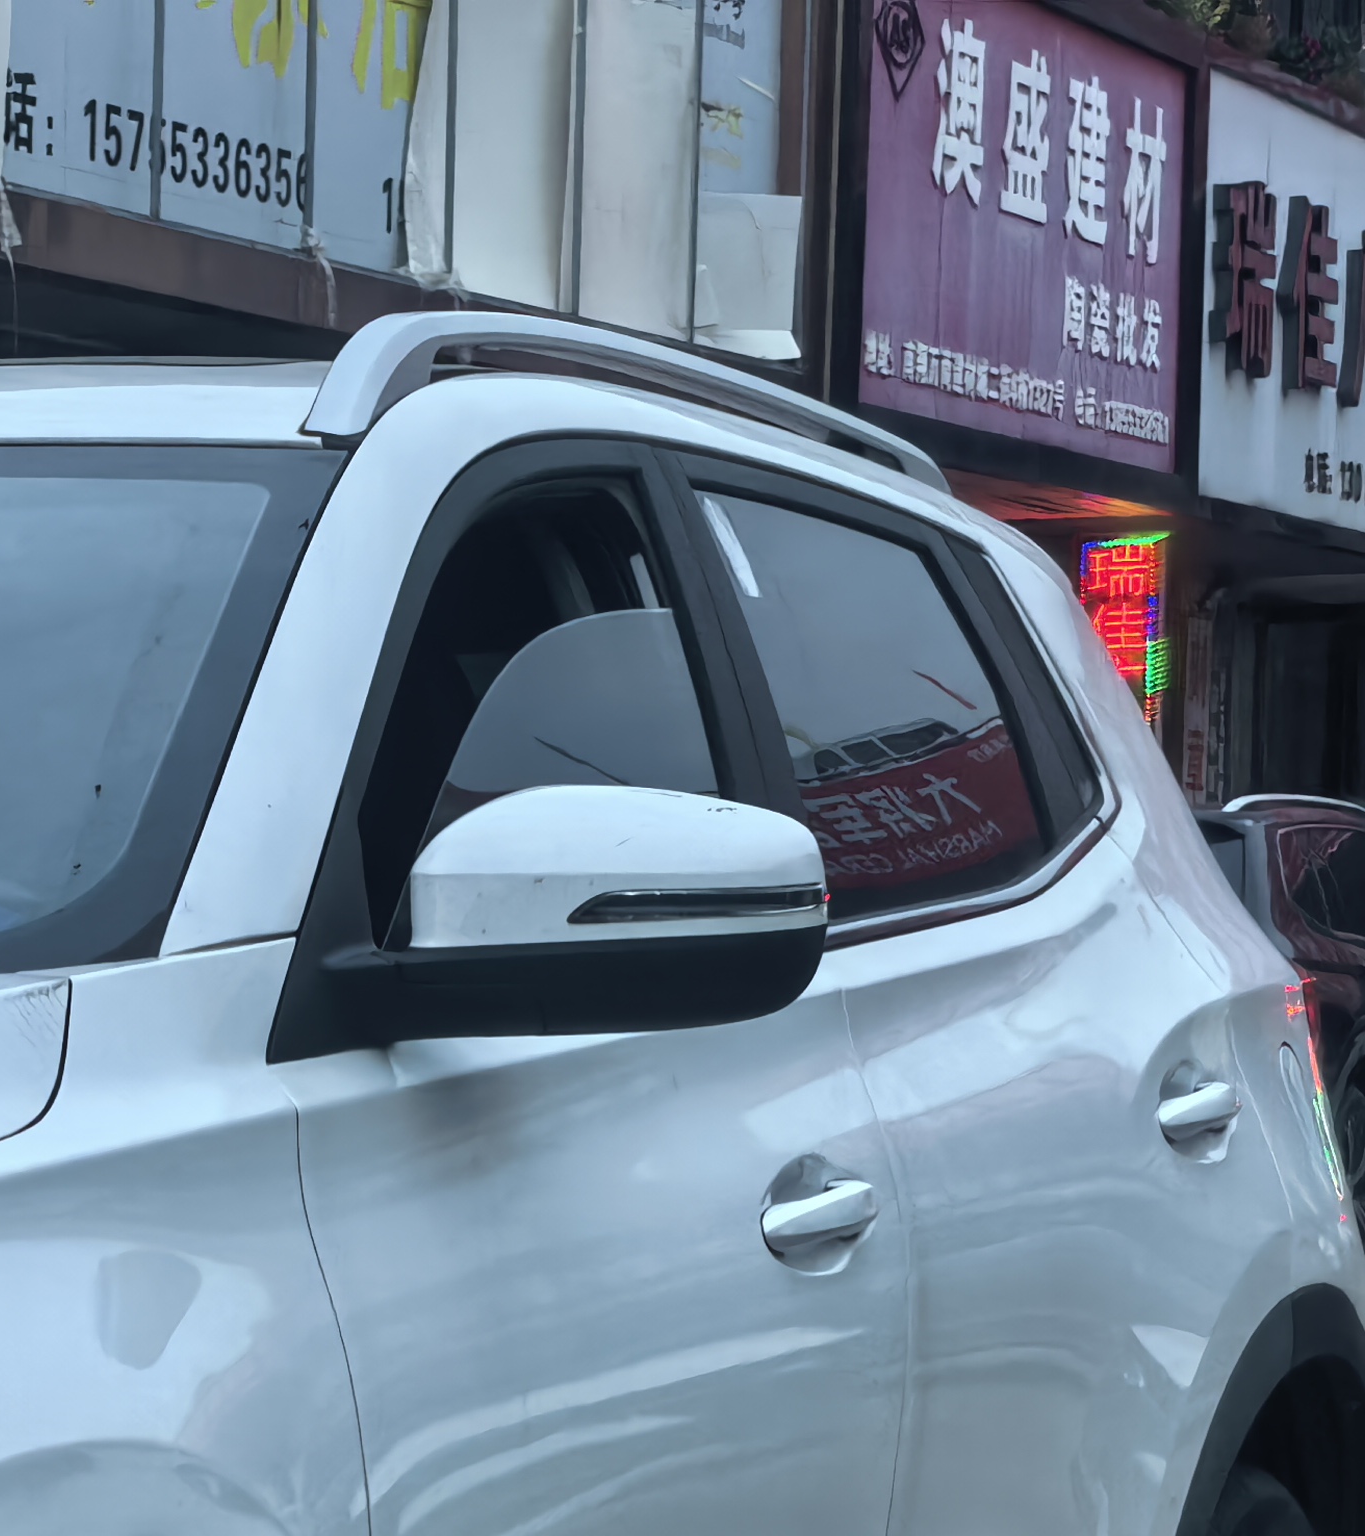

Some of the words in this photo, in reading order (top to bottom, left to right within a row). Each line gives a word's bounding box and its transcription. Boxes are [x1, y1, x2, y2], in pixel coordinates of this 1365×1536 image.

[932, 17, 1166, 265] 澳盛建材
[1063, 274, 1163, 371] 陶瓷批发
[1085, 541, 1151, 674] 瑞佳
